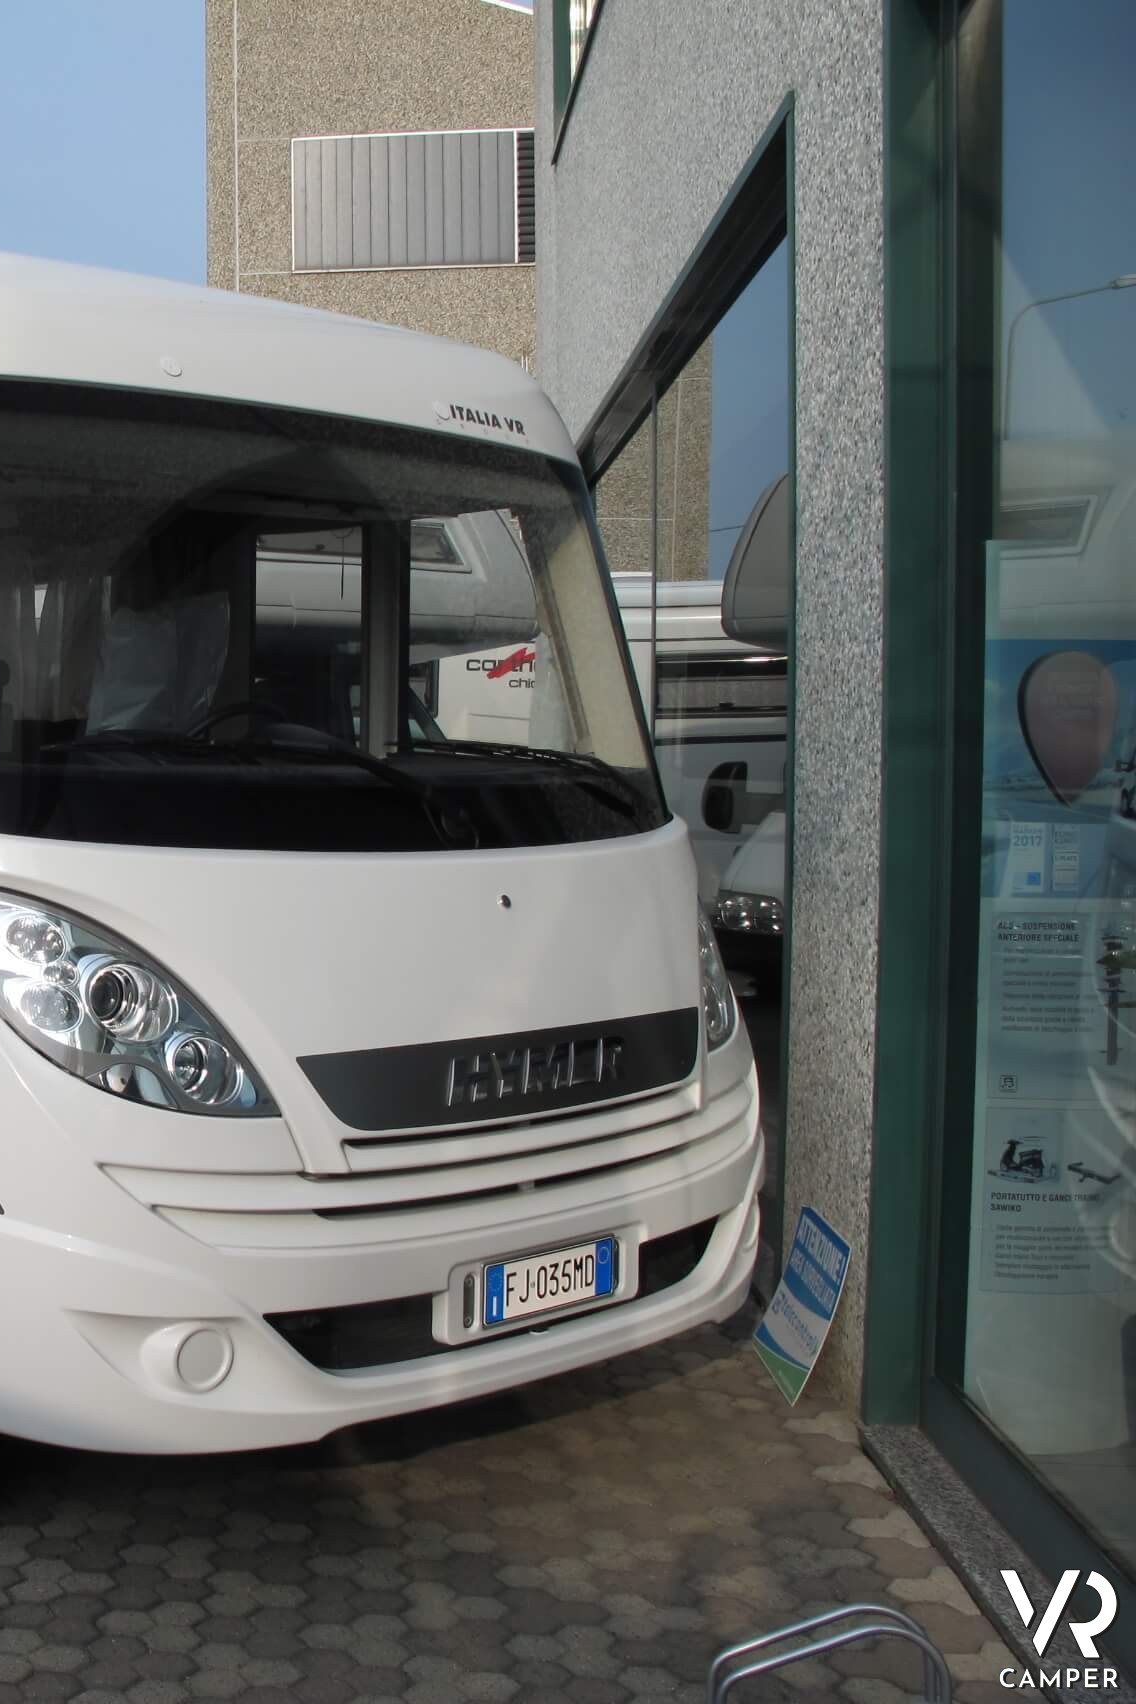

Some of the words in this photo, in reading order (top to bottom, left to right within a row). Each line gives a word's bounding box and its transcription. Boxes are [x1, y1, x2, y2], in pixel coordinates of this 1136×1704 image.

[449, 404, 501, 429] ITALIA
[503, 417, 526, 435] VR
[1013, 835, 1042, 847] 2017
[991, 1191, 1041, 1203] PORTATUTTO
[990, 1204, 1023, 1214] SAWIKO
